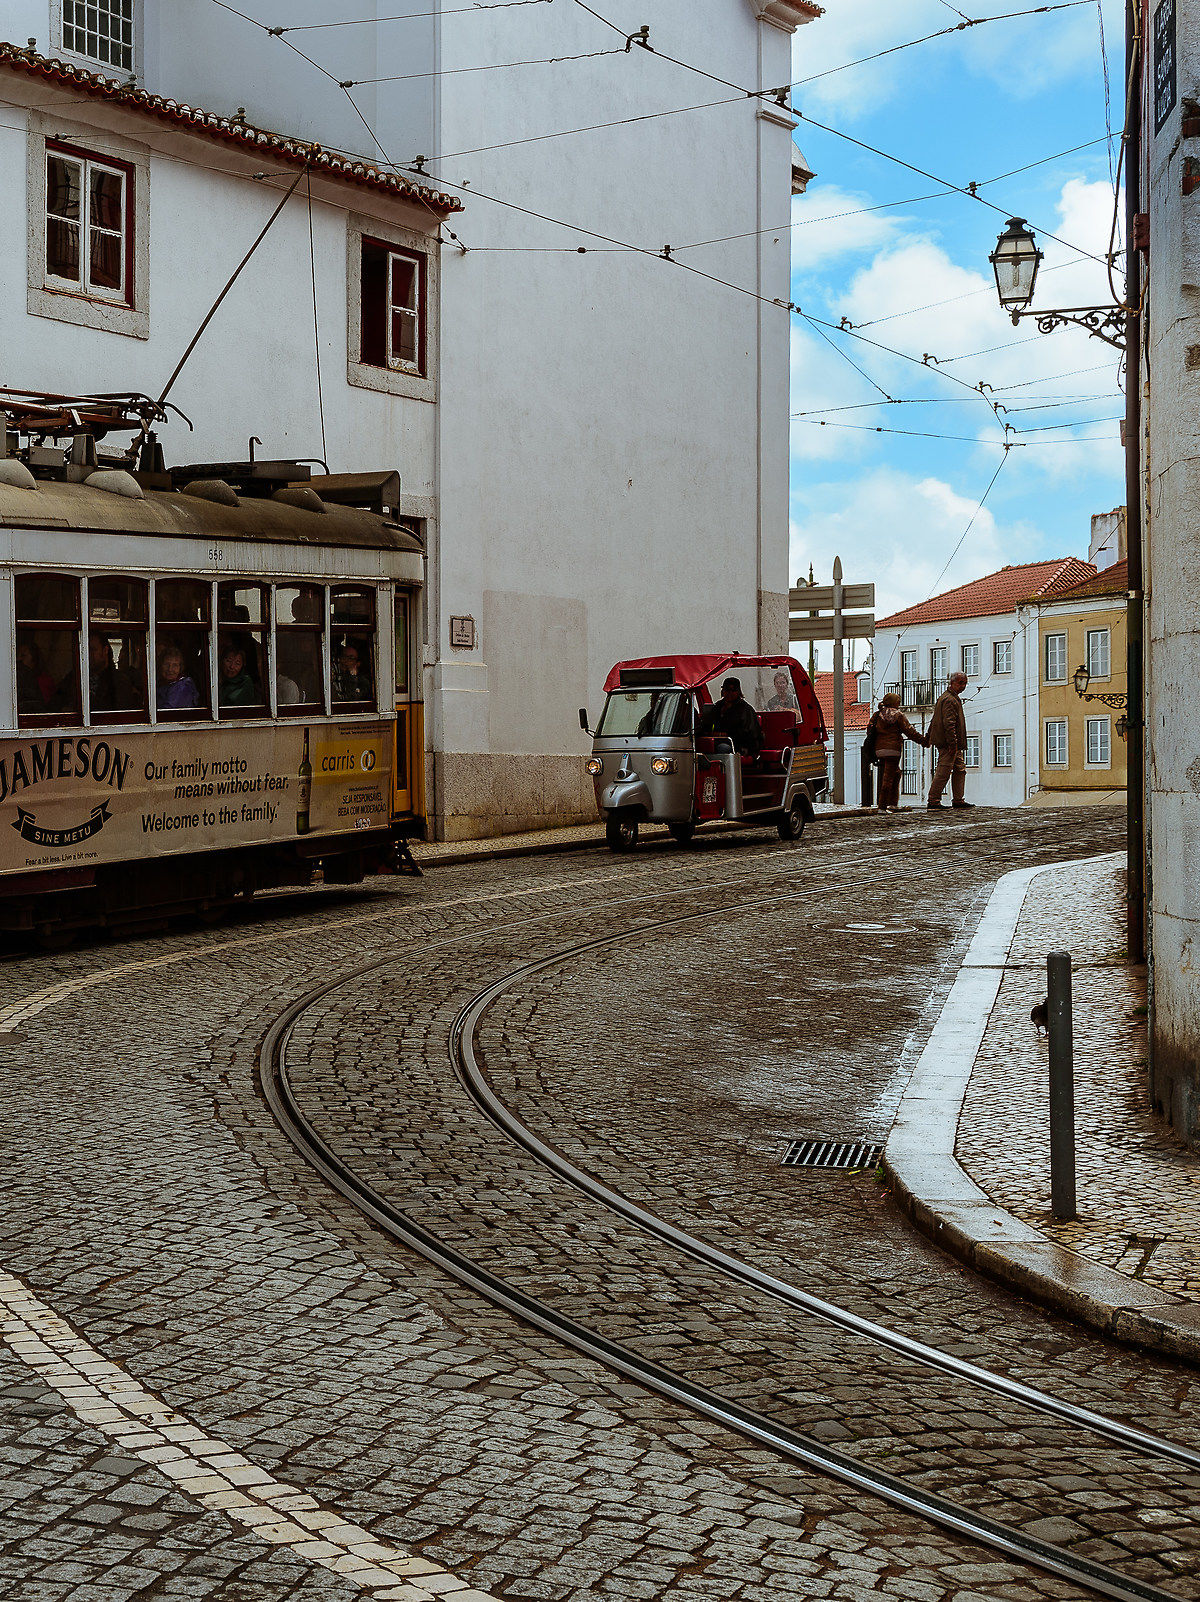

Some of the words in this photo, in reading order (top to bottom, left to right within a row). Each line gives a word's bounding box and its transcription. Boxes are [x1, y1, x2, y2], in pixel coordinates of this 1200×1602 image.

[208, 549, 223, 561] 558
[144, 761, 168, 780] Our
[171, 758, 209, 780] family
[211, 756, 247, 775] motto
[321, 749, 355, 771] carris
[174, 782, 214, 799] means
[216, 775, 262, 796] without
[263, 773, 289, 791] fear.
[141, 812, 200, 833] Welcome
[202, 809, 216, 826] to
[218, 805, 238, 824] the
[34, 831, 60, 844] SINE
[64, 826, 91, 843] METU
